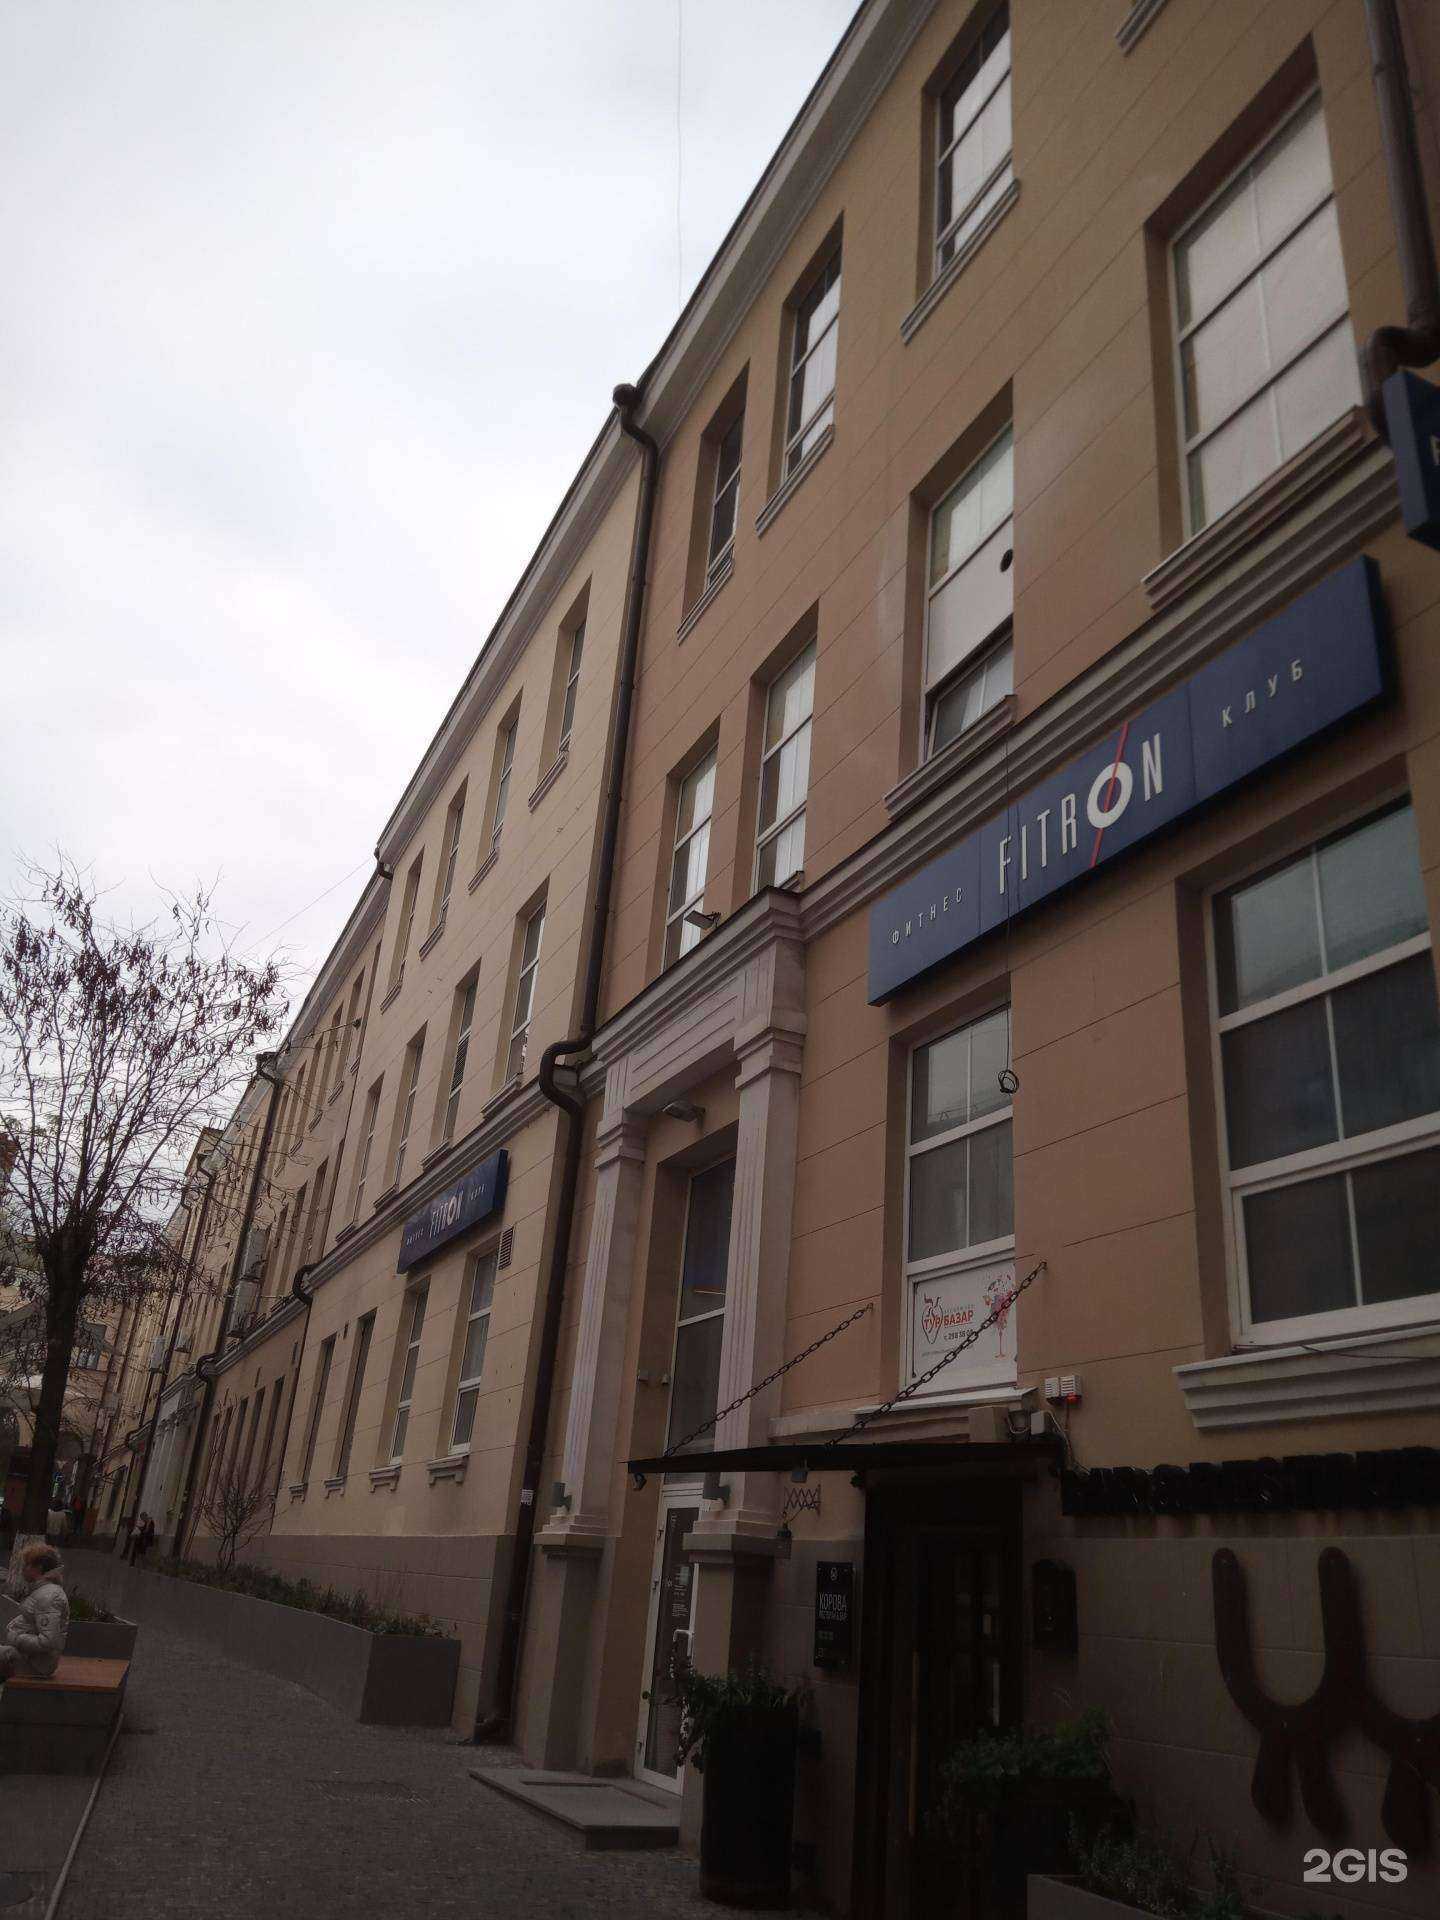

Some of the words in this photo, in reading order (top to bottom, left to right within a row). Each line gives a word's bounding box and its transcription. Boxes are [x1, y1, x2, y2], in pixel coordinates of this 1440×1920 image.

[892, 887, 963, 944] ФИТНЕС
[999, 733, 1163, 895] FITRON
[1221, 658, 1303, 728] КЛУБ
